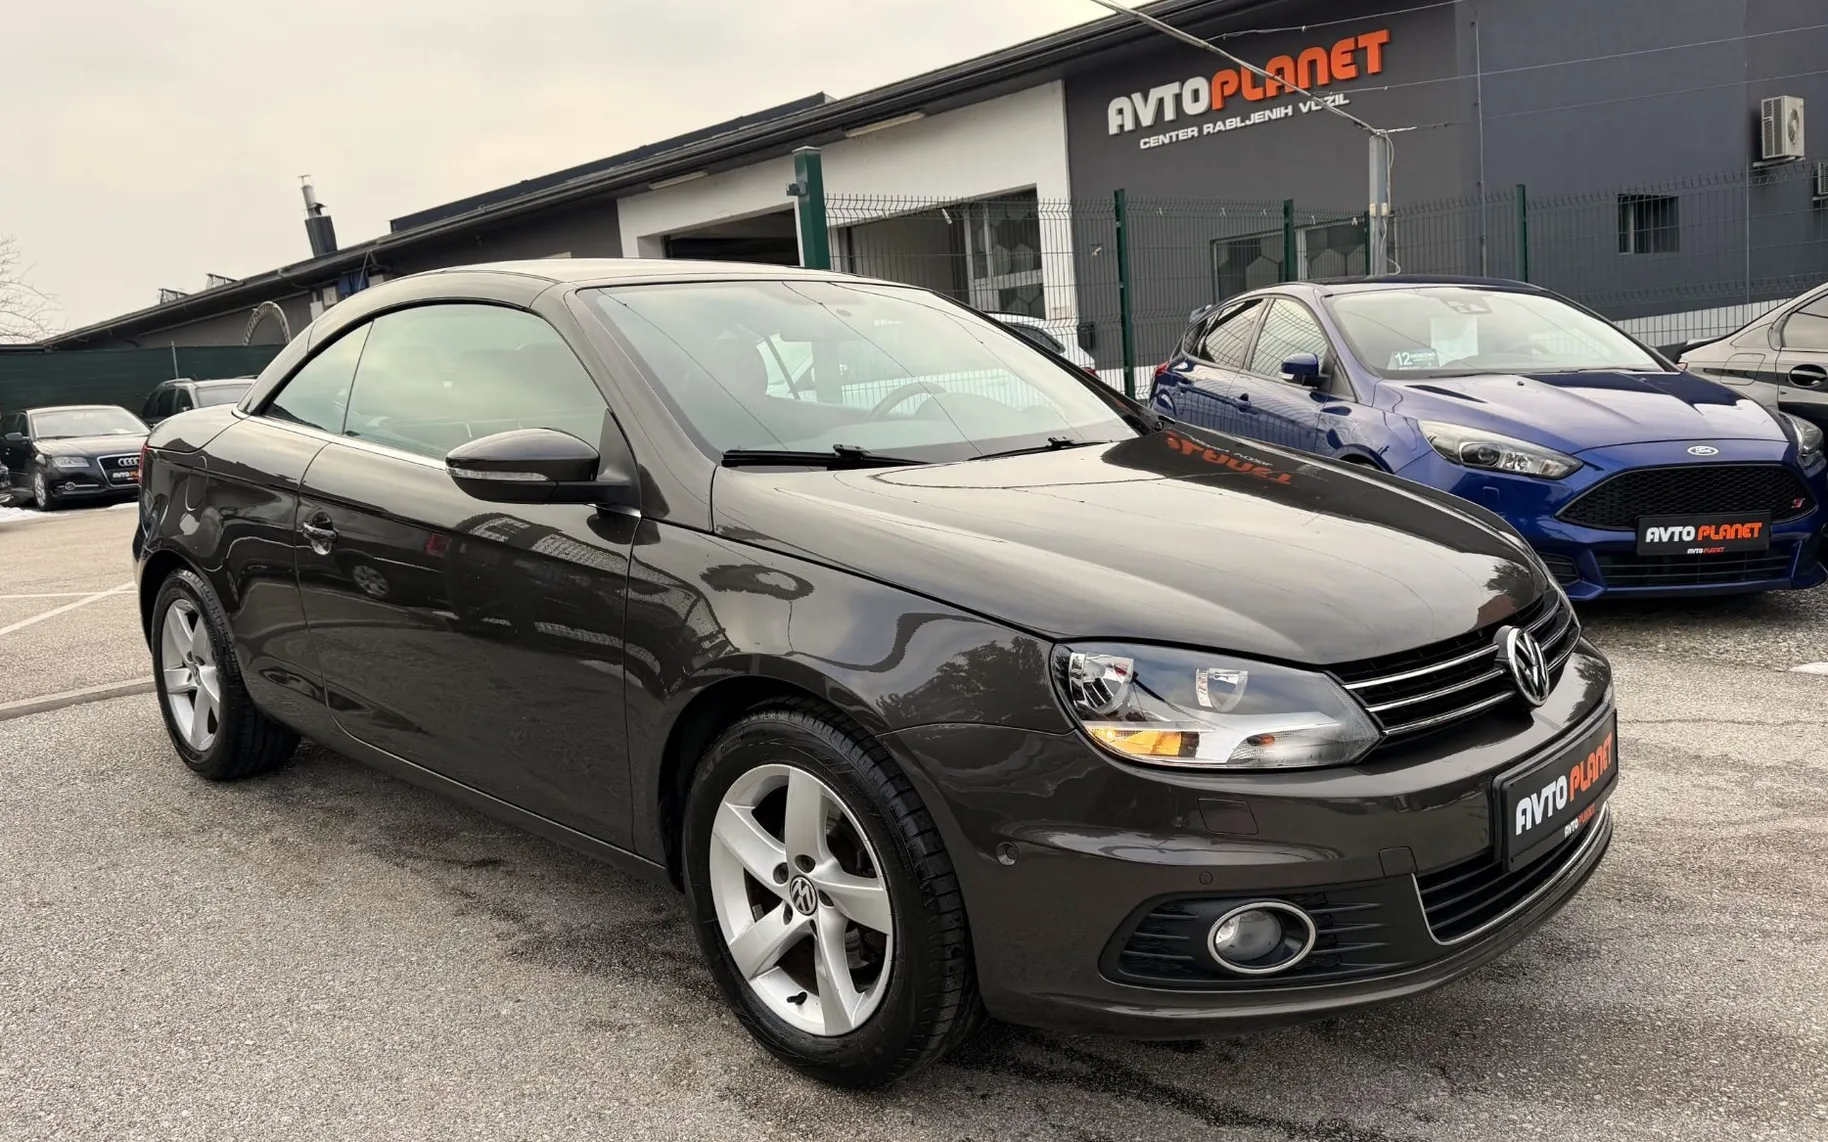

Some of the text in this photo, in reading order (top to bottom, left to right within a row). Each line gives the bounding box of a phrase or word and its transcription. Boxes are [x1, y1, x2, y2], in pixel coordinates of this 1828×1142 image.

[1139, 127, 1199, 150] CENTER
[1203, 104, 1293, 137] RABLJENIH
[1395, 351, 1413, 366] 12
[1645, 522, 1763, 543] AVTO PLANET
[1515, 731, 1613, 836] AVTO PLANET
